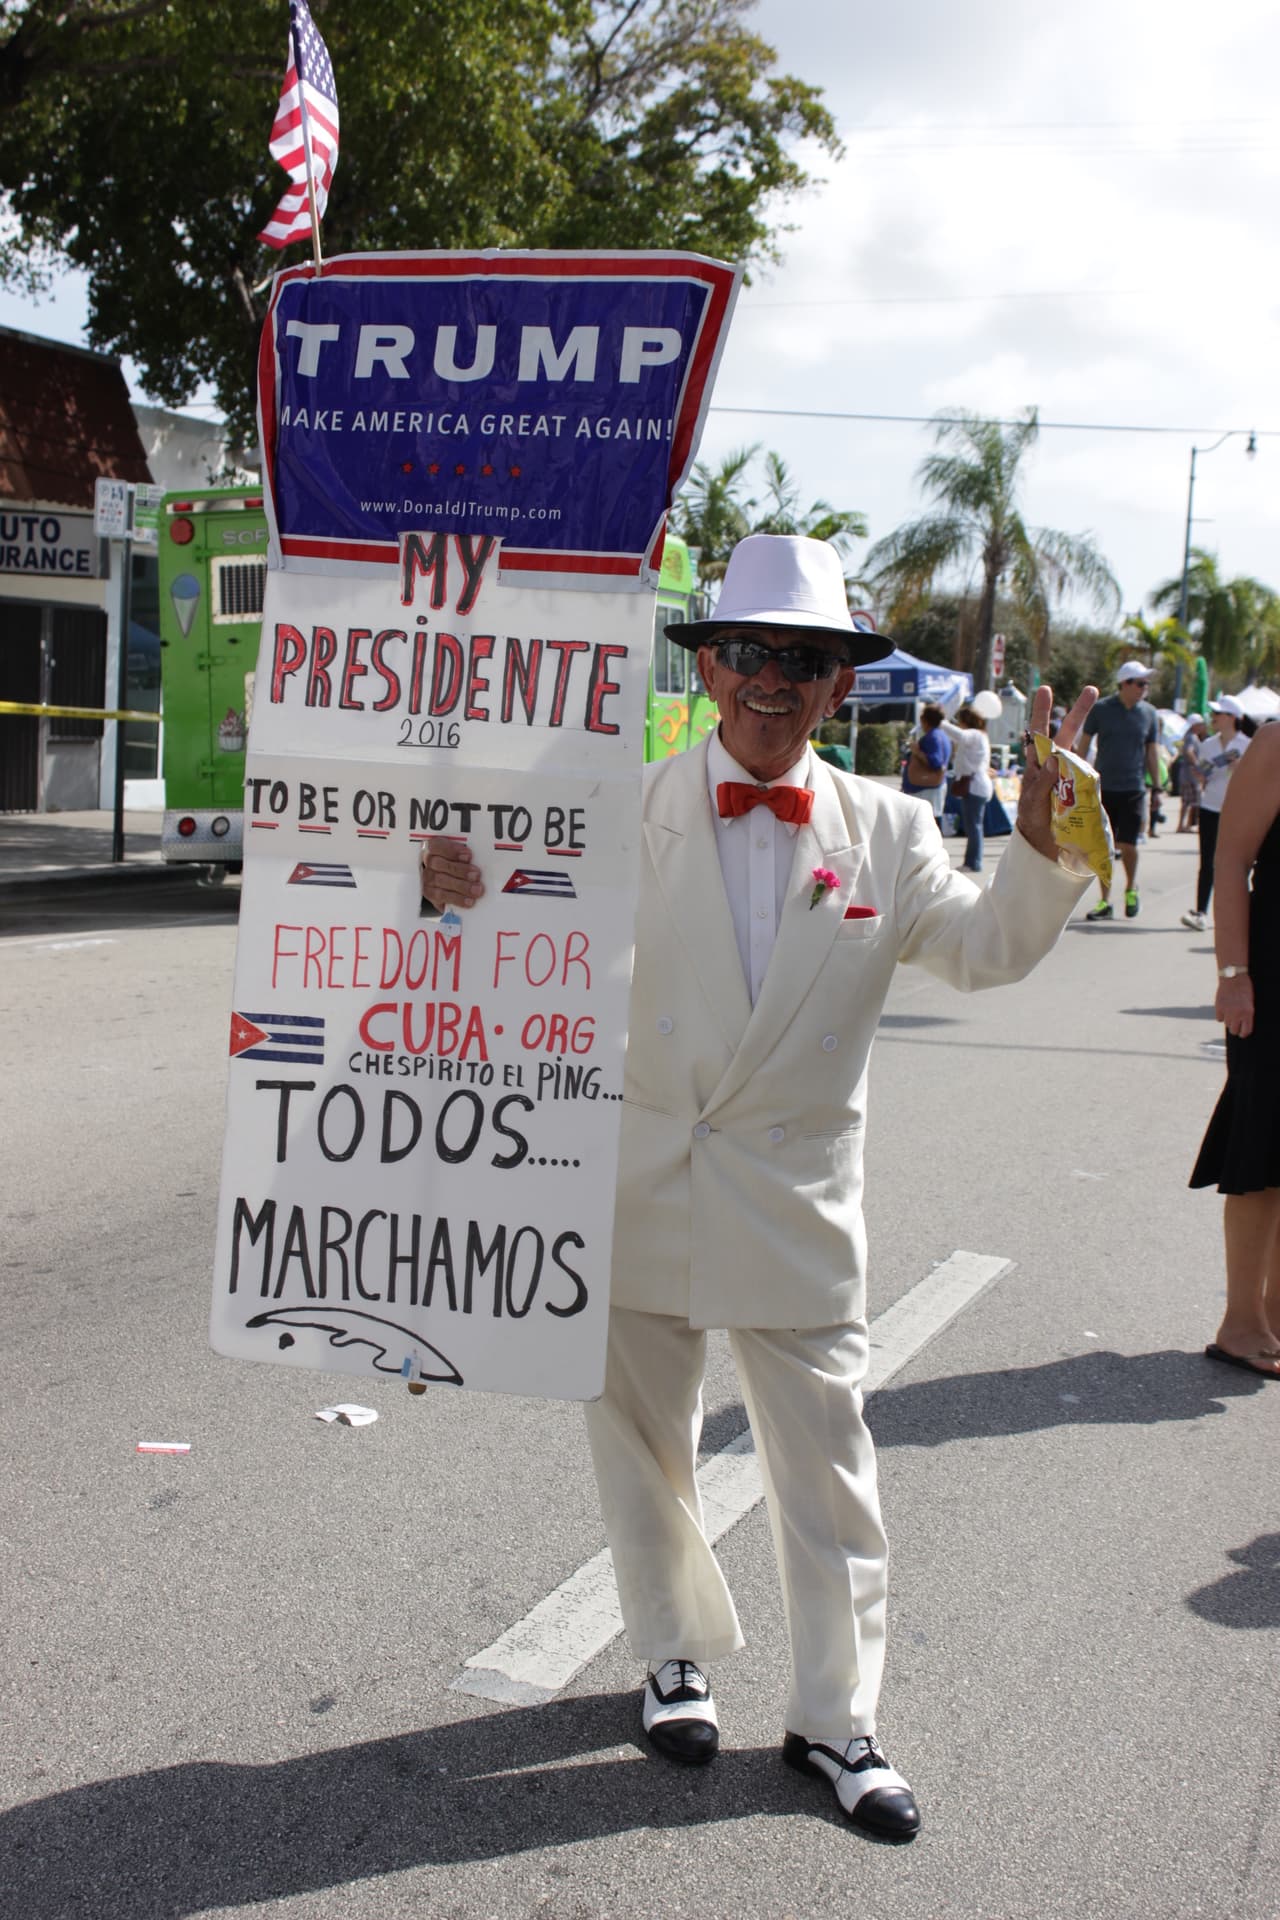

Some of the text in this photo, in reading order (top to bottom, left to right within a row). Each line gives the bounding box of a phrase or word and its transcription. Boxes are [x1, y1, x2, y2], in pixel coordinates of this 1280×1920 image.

[286, 320, 683, 384] TRUMP
[280, 405, 674, 441] MAKE AMERICA GREAT AGAIN!
[360, 499, 562, 520] www.DonaldJTrump.com
[401, 533, 497, 616] MY
[270, 616, 629, 735] PRESIDENTE
[398, 716, 461, 748] 2016
[248, 778, 586, 849] TO BE OR NOT TO BE
[272, 924, 591, 992] FREEDOM FOR
[521, 1013, 597, 1055] ORG
[348, 1051, 495, 1087] CHESPIRITO
[503, 1065, 525, 1088] EL
[229, 1197, 589, 1319] MARCHAMOS
